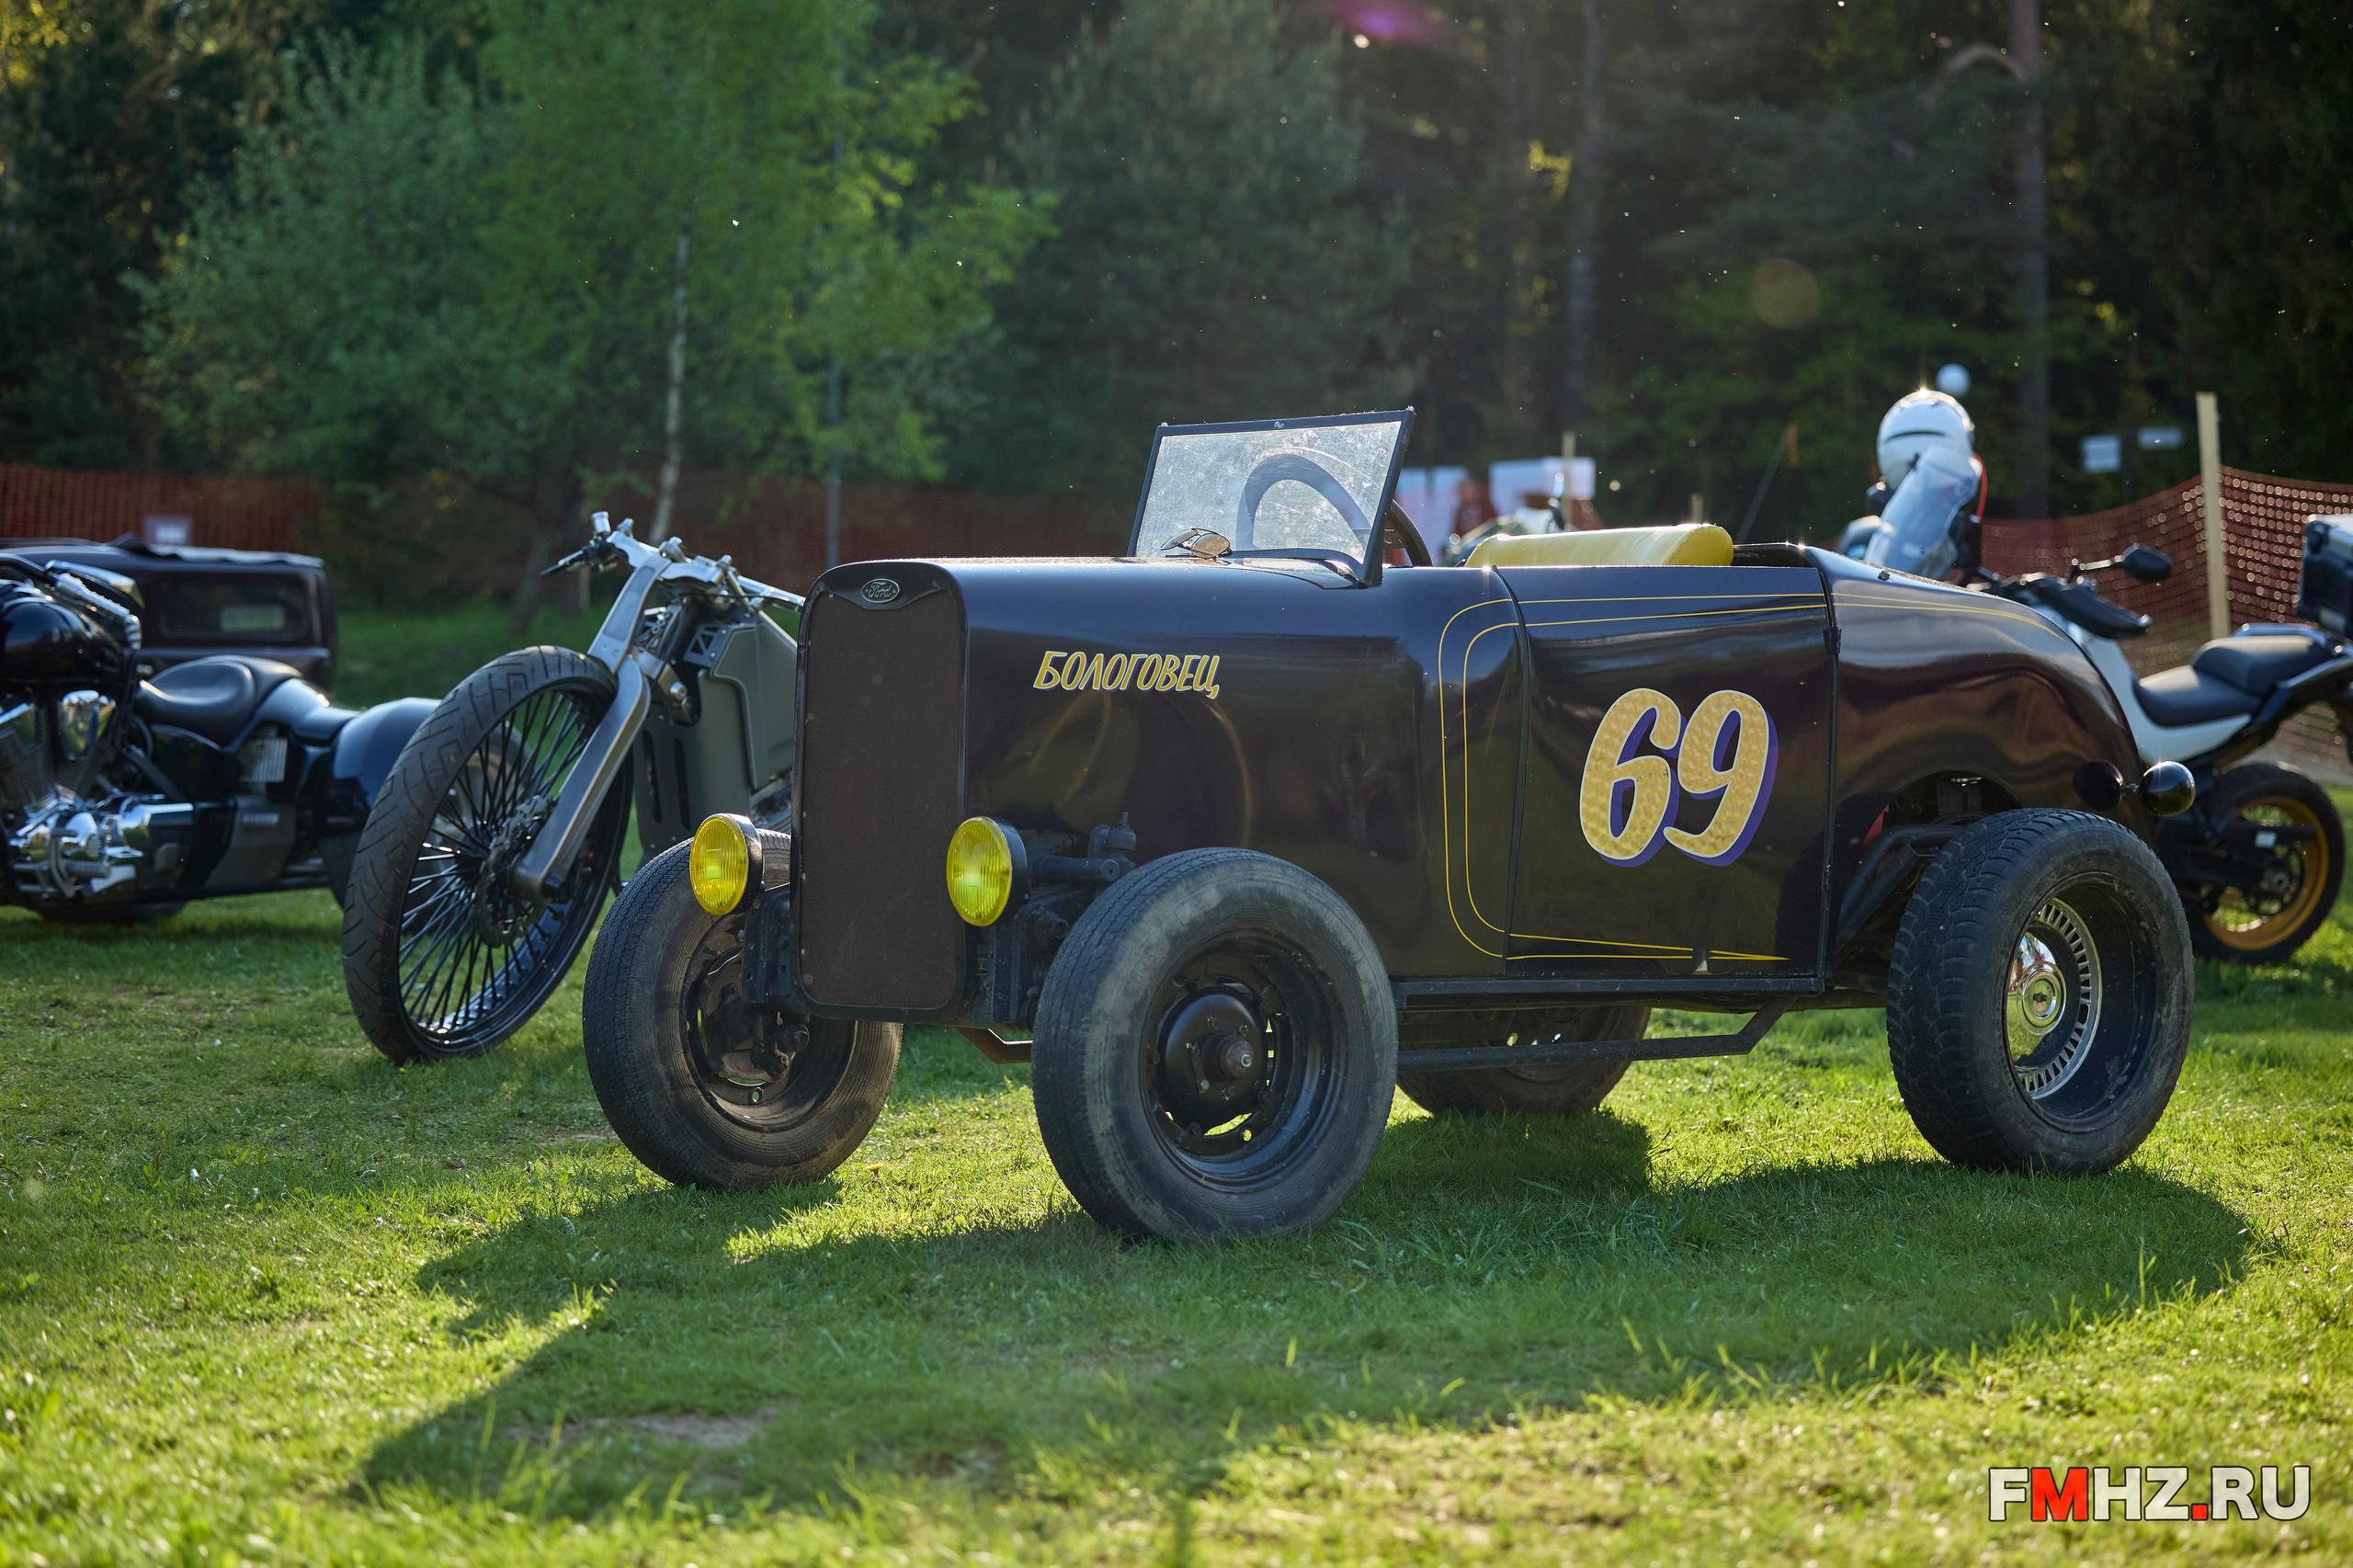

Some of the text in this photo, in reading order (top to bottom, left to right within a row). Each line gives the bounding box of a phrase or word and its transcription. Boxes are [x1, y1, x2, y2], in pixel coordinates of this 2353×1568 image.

[868, 581, 892, 598] Ford
[1032, 651, 1221, 700] БОЛОГОВЕЦ
[1579, 687, 1775, 865] 69
